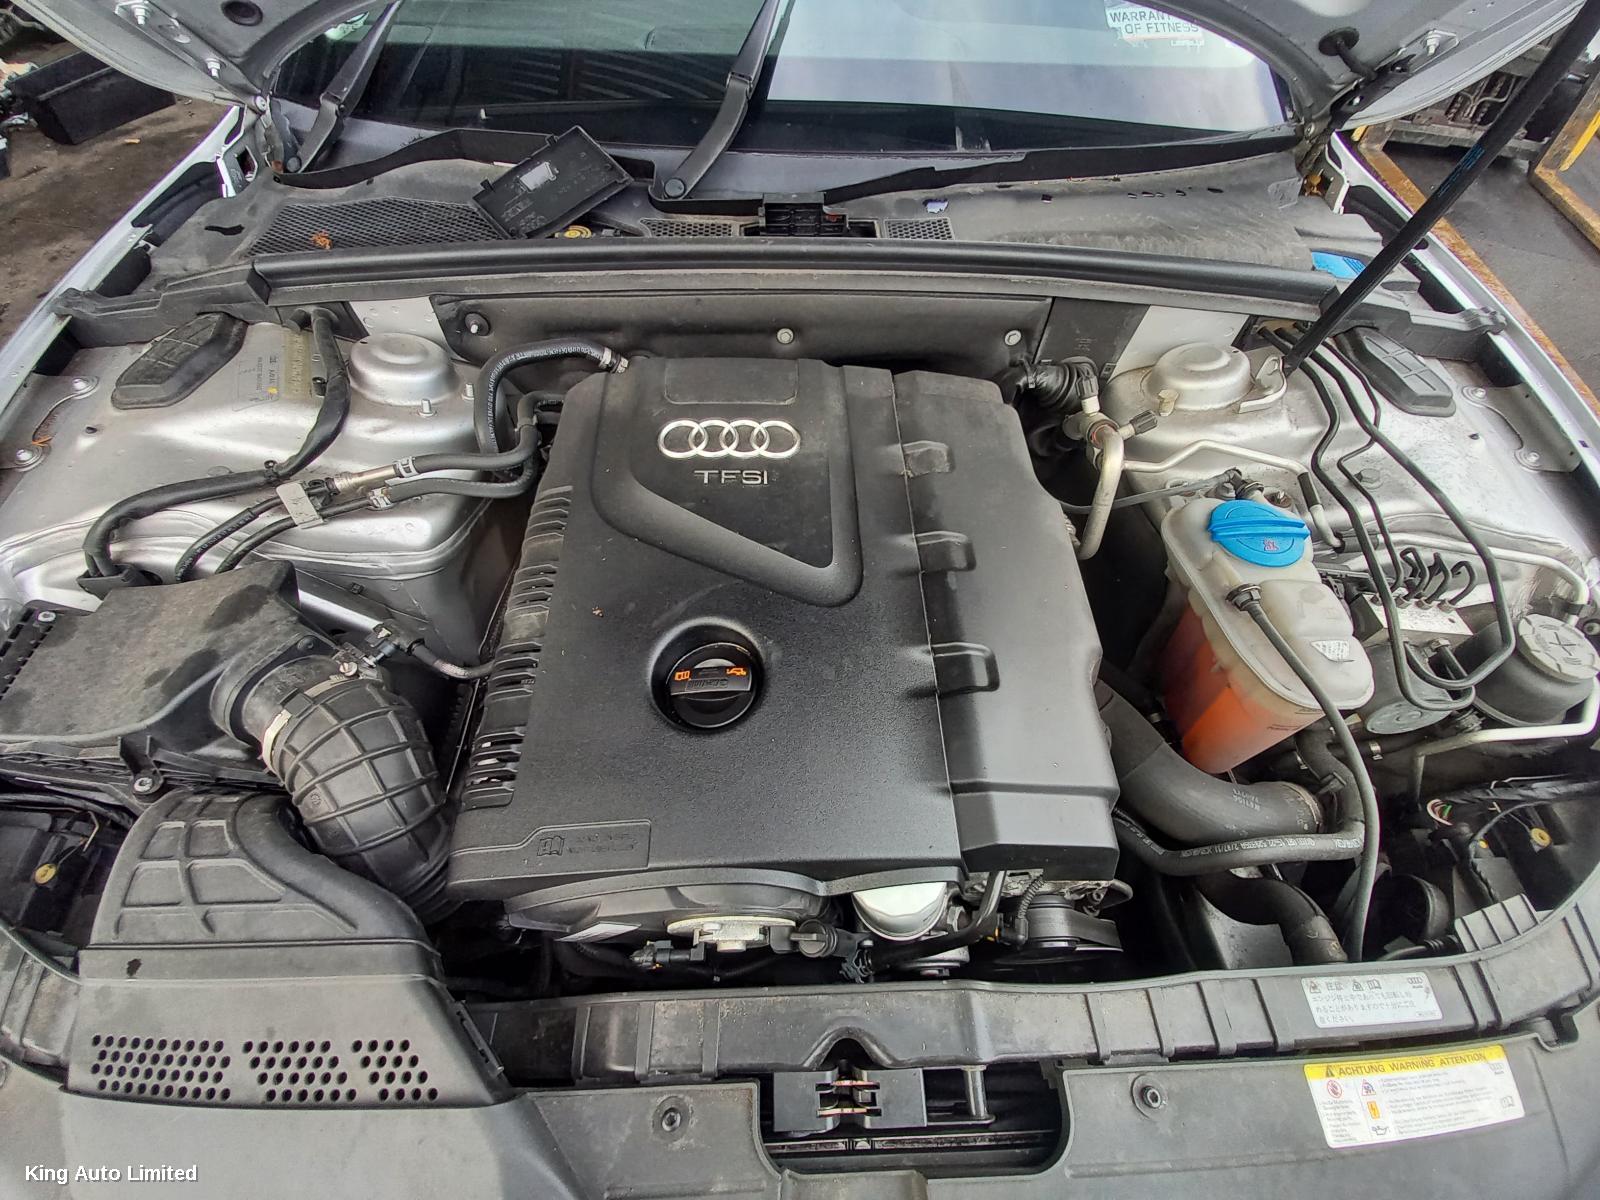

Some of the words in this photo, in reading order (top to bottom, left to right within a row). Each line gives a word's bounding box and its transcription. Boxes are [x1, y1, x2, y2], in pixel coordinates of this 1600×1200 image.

[1124, 23, 1142, 34] OF
[1146, 22, 1199, 32] FITNESS
[694, 470, 768, 485] TFSI
[1338, 1063, 1385, 1076] ACHTUNG
[1389, 1058, 1434, 1072] WARNING
[1439, 1052, 1487, 1067] ATTENTION
